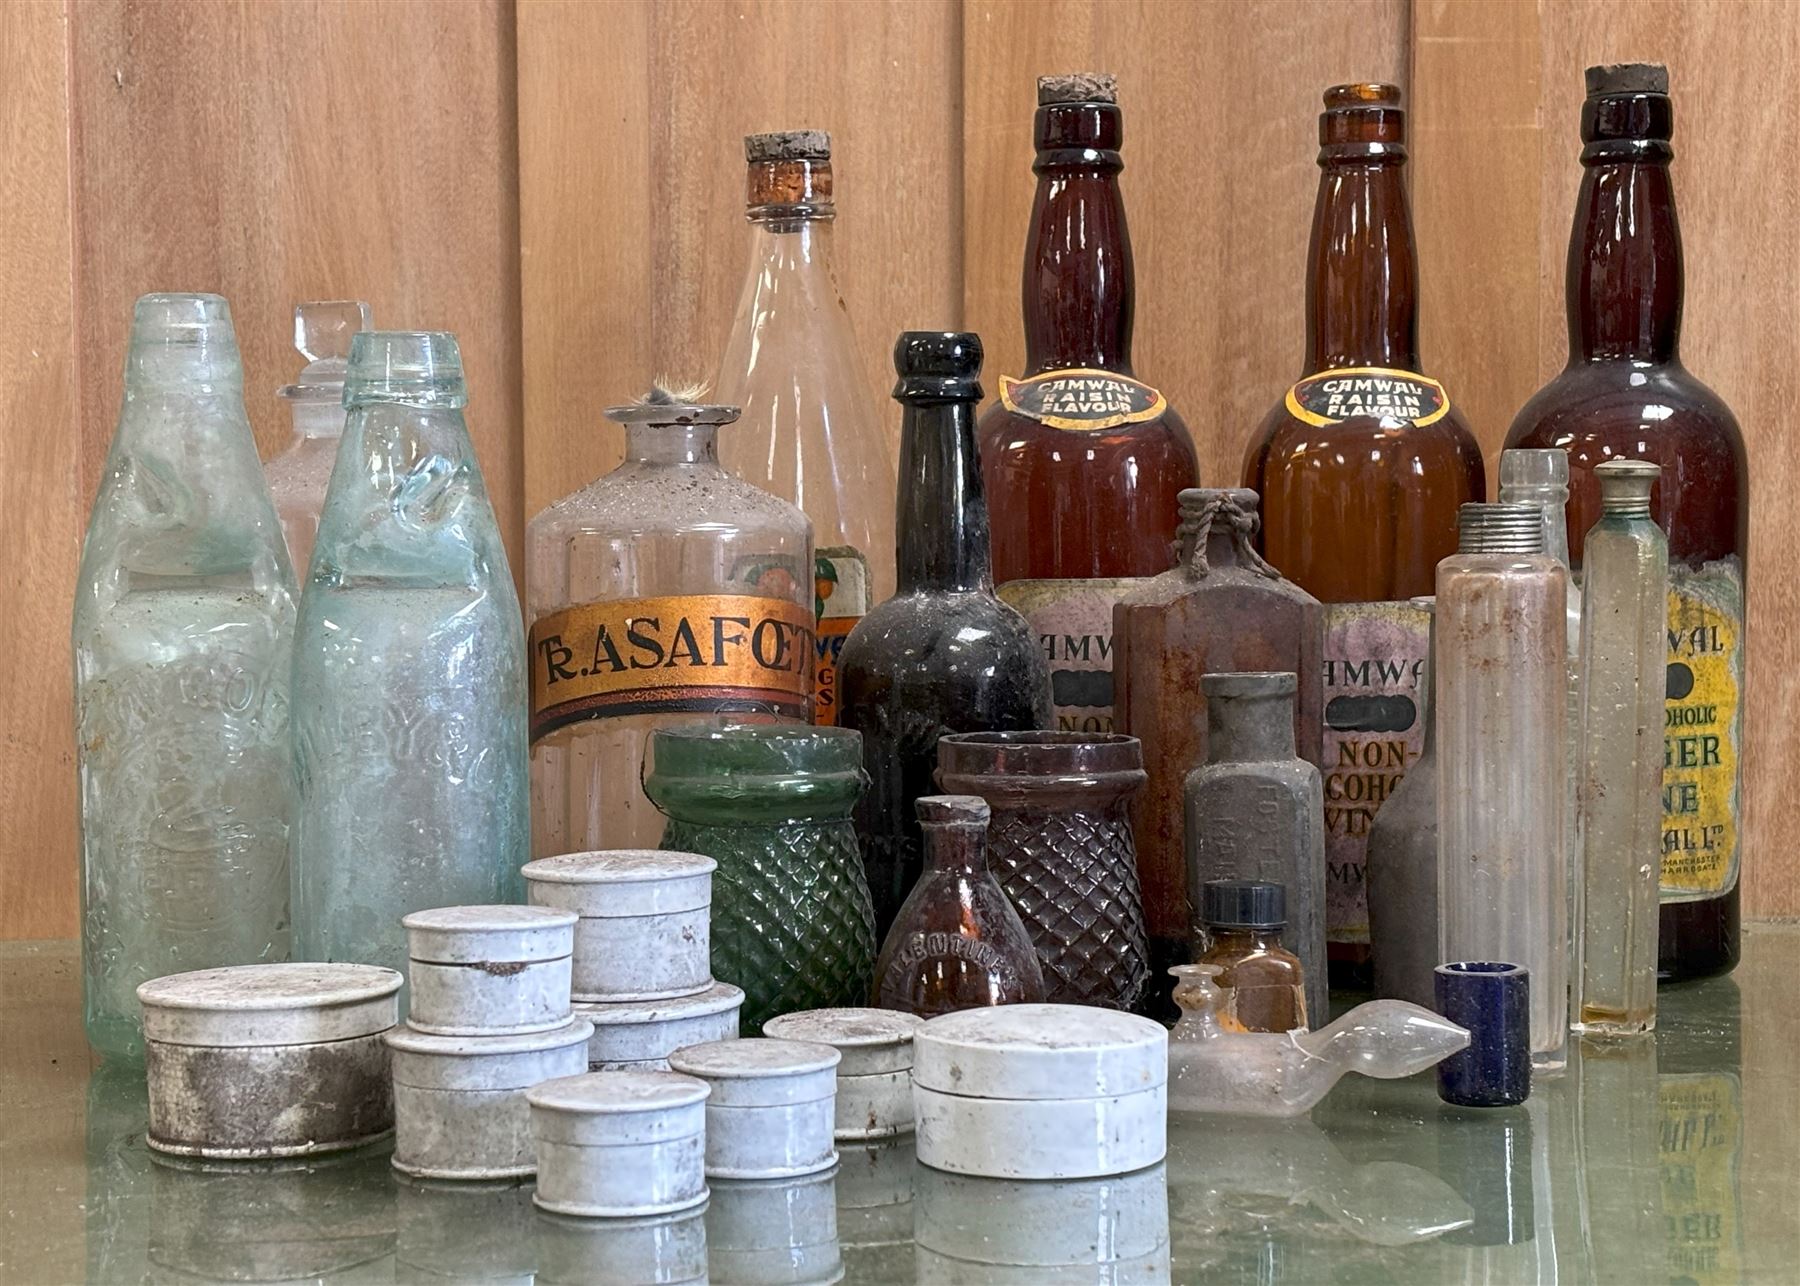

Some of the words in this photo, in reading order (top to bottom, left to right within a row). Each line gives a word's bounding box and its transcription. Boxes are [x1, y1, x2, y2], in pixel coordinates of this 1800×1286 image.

[1037, 379, 1135, 394] CAMWAL
[1322, 379, 1422, 395] CAMWAL
[1042, 392, 1132, 404] RAISIN
[1328, 393, 1421, 407] RAISIN
[1041, 401, 1132, 414] FLAVOUR
[1326, 404, 1420, 418] FLAVOUR
